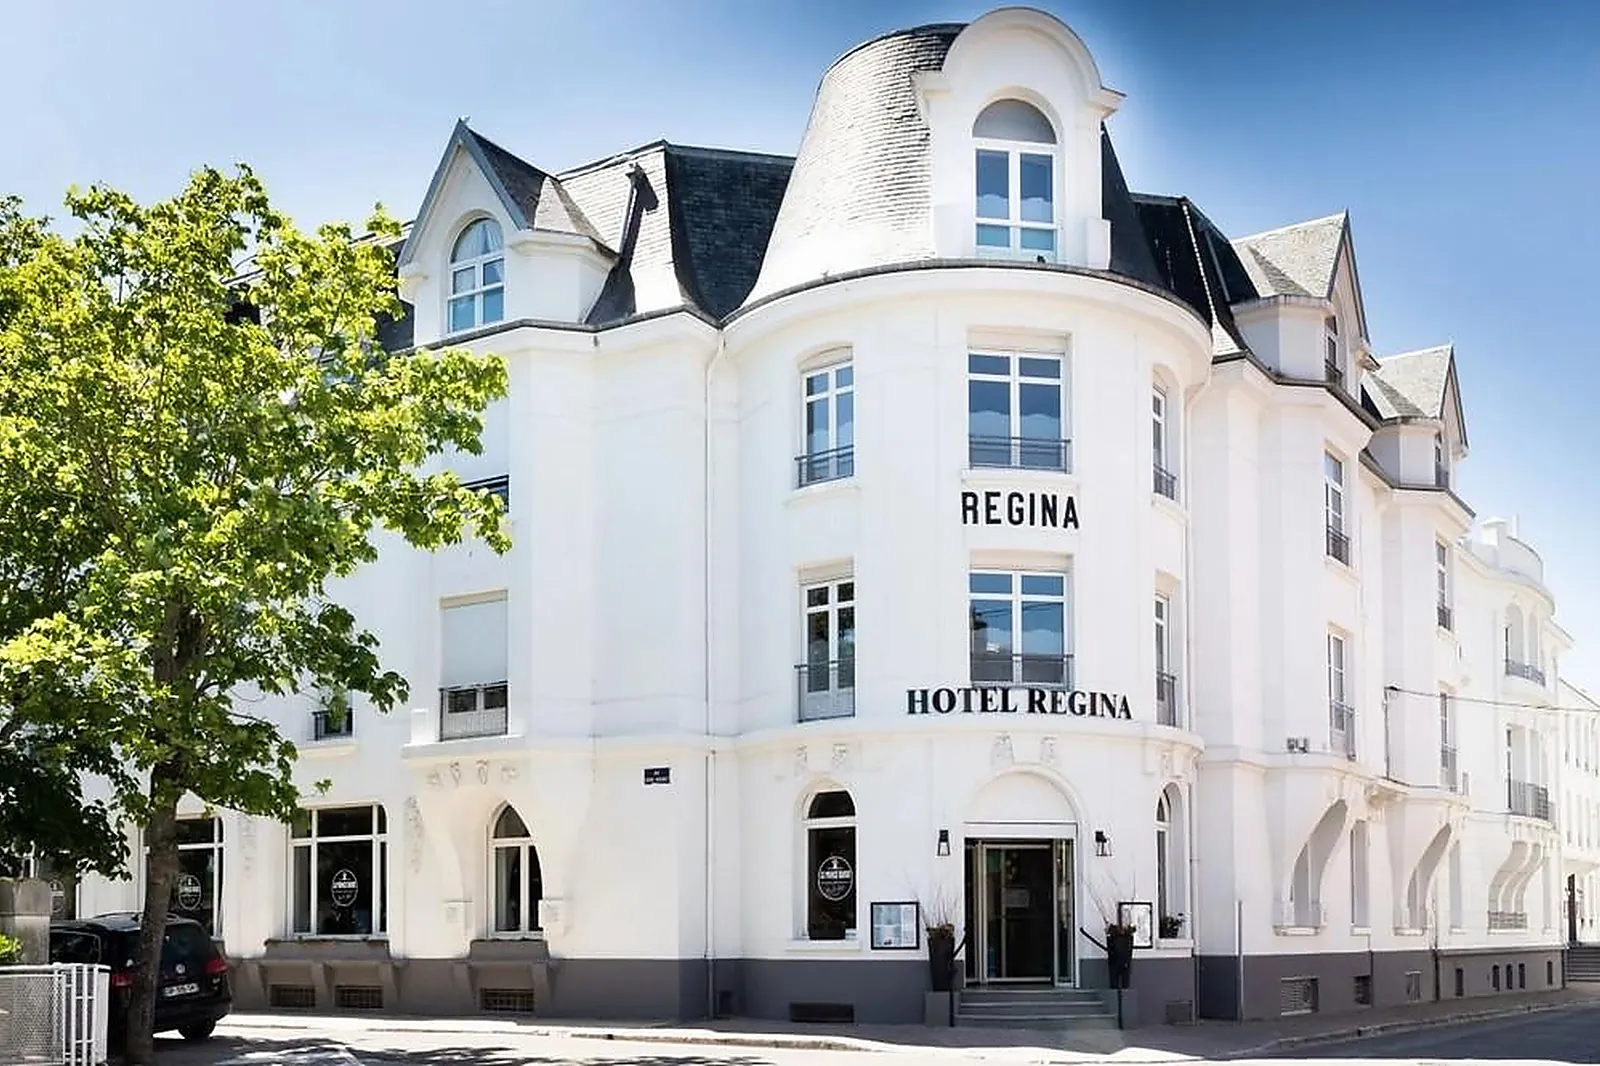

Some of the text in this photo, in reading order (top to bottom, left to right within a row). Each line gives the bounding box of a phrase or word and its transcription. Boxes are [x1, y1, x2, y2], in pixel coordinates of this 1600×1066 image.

[961, 491, 1079, 530] REGINA
[906, 687, 1133, 720] HOTEL REGINA
